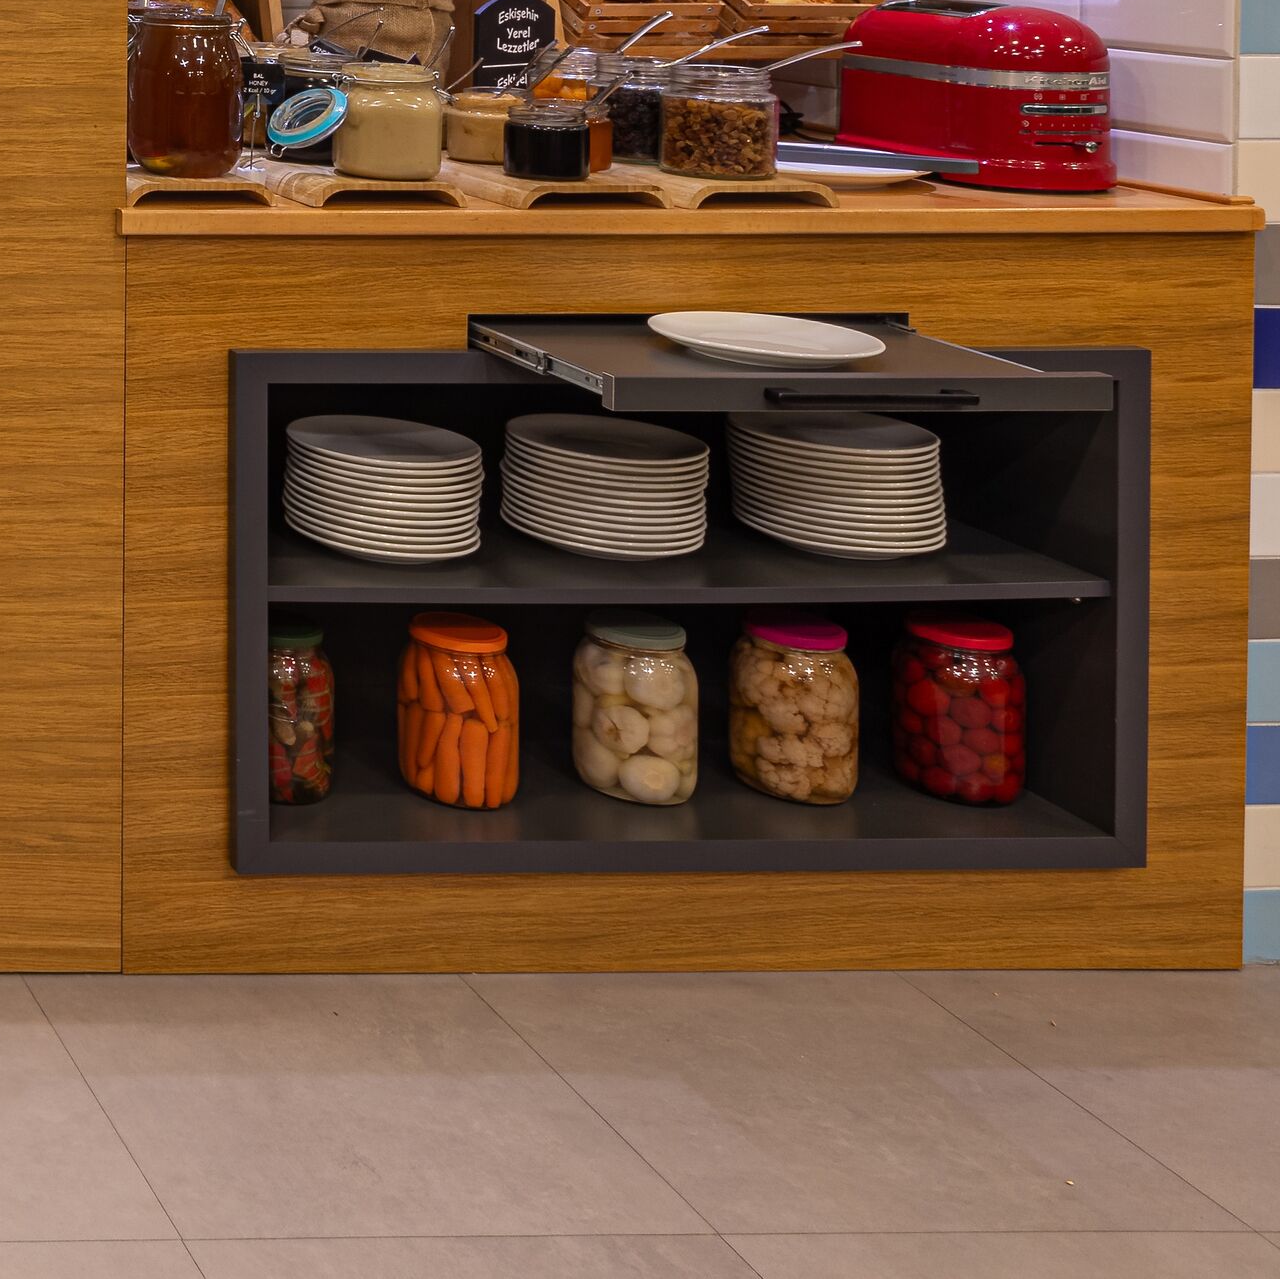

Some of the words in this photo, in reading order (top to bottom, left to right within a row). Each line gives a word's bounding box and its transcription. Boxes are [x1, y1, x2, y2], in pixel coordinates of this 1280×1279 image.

[498, 7, 539, 24] Eskişehir
[507, 26, 530, 39] Yerel
[497, 37, 539, 53] Lezzetler
